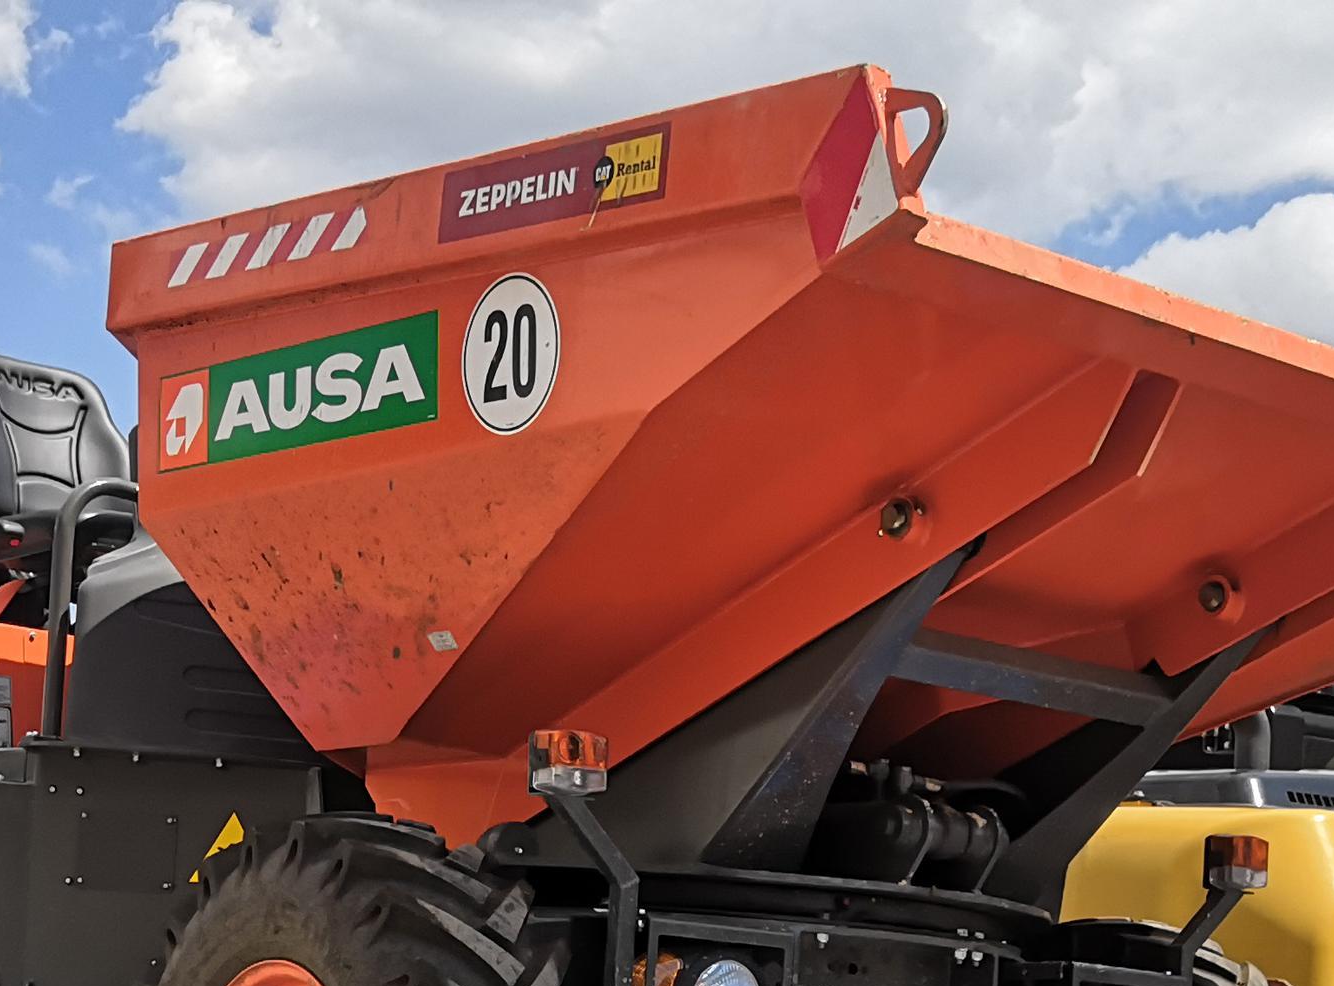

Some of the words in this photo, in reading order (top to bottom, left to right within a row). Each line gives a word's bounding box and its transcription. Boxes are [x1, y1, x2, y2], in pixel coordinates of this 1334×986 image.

[458, 167, 576, 217] ZEPPELIN
[595, 164, 612, 183] CAT
[616, 155, 656, 177] Rental
[214, 344, 425, 442] AUSA
[483, 303, 537, 403] 20
